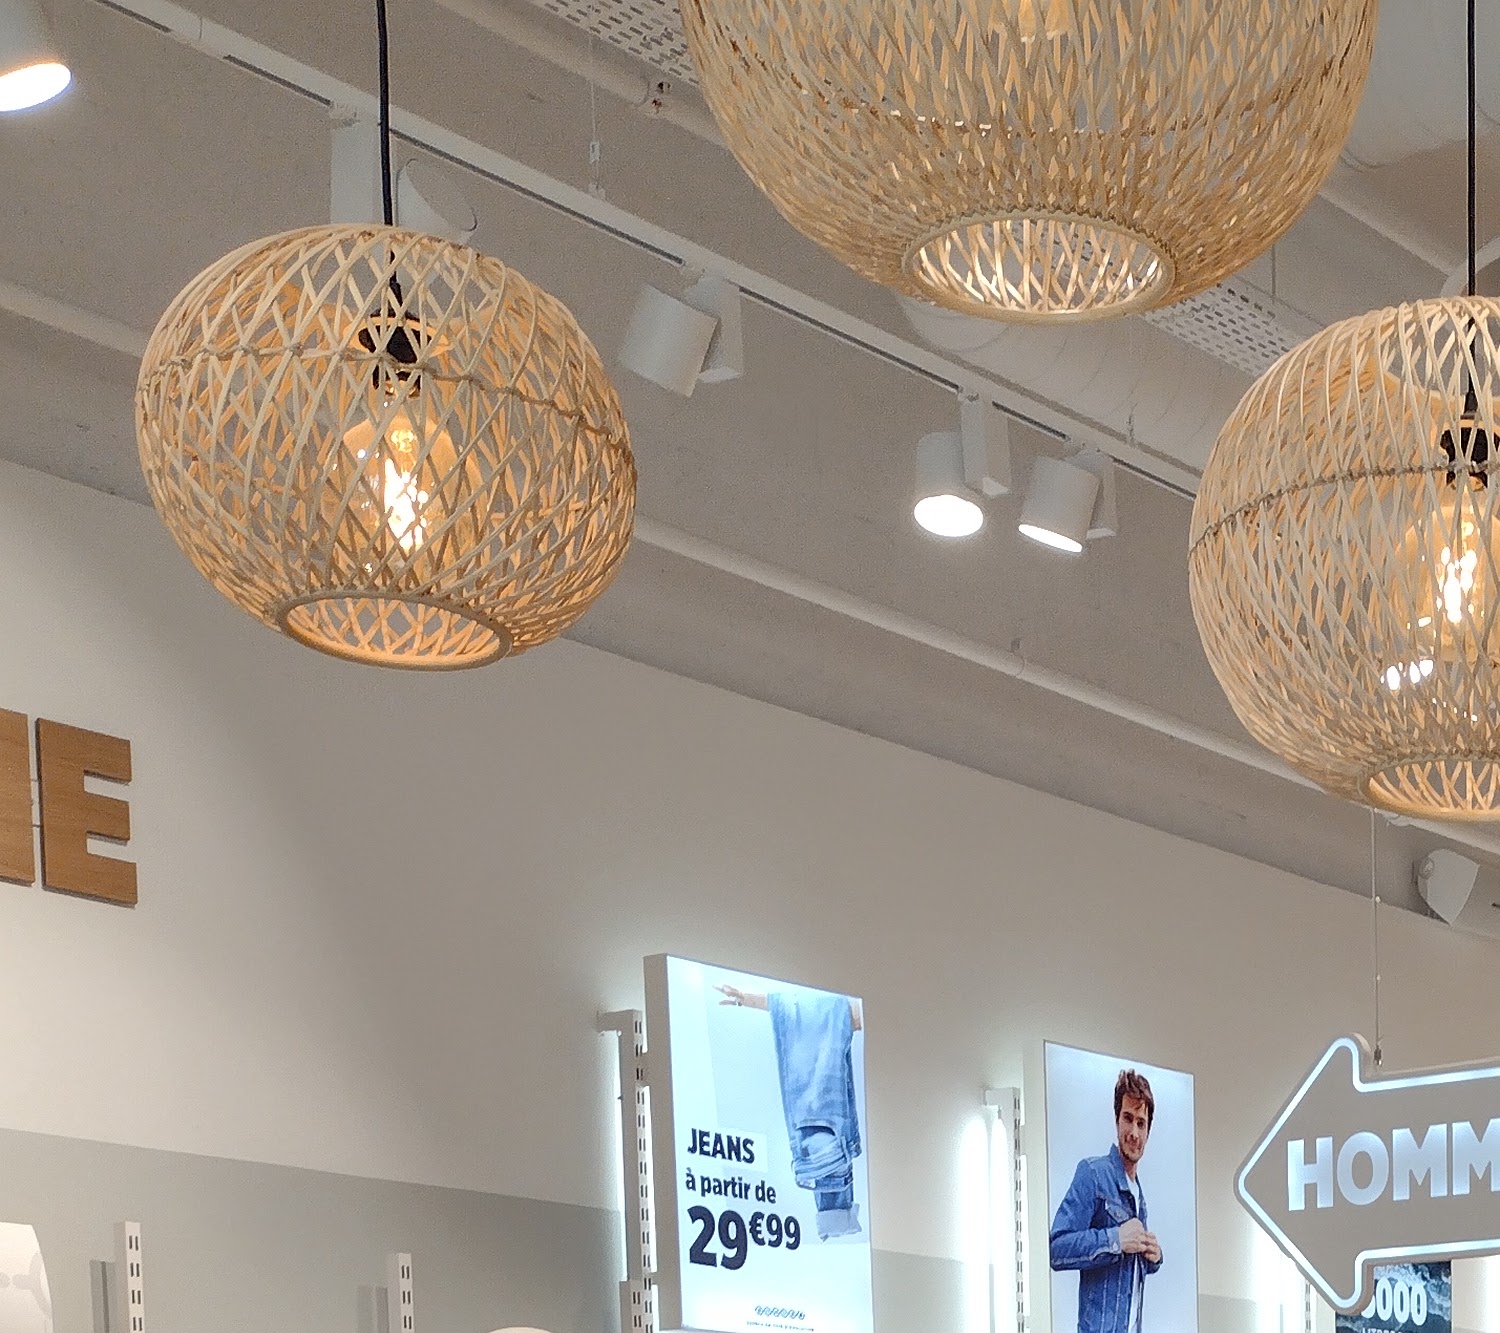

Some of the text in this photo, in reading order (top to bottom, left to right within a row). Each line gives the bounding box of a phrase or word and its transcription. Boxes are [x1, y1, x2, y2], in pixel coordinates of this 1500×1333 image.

[687, 1127, 756, 1165] JEANS
[685, 1167, 777, 1204] à partir de
[687, 1205, 801, 1271] 29€99
